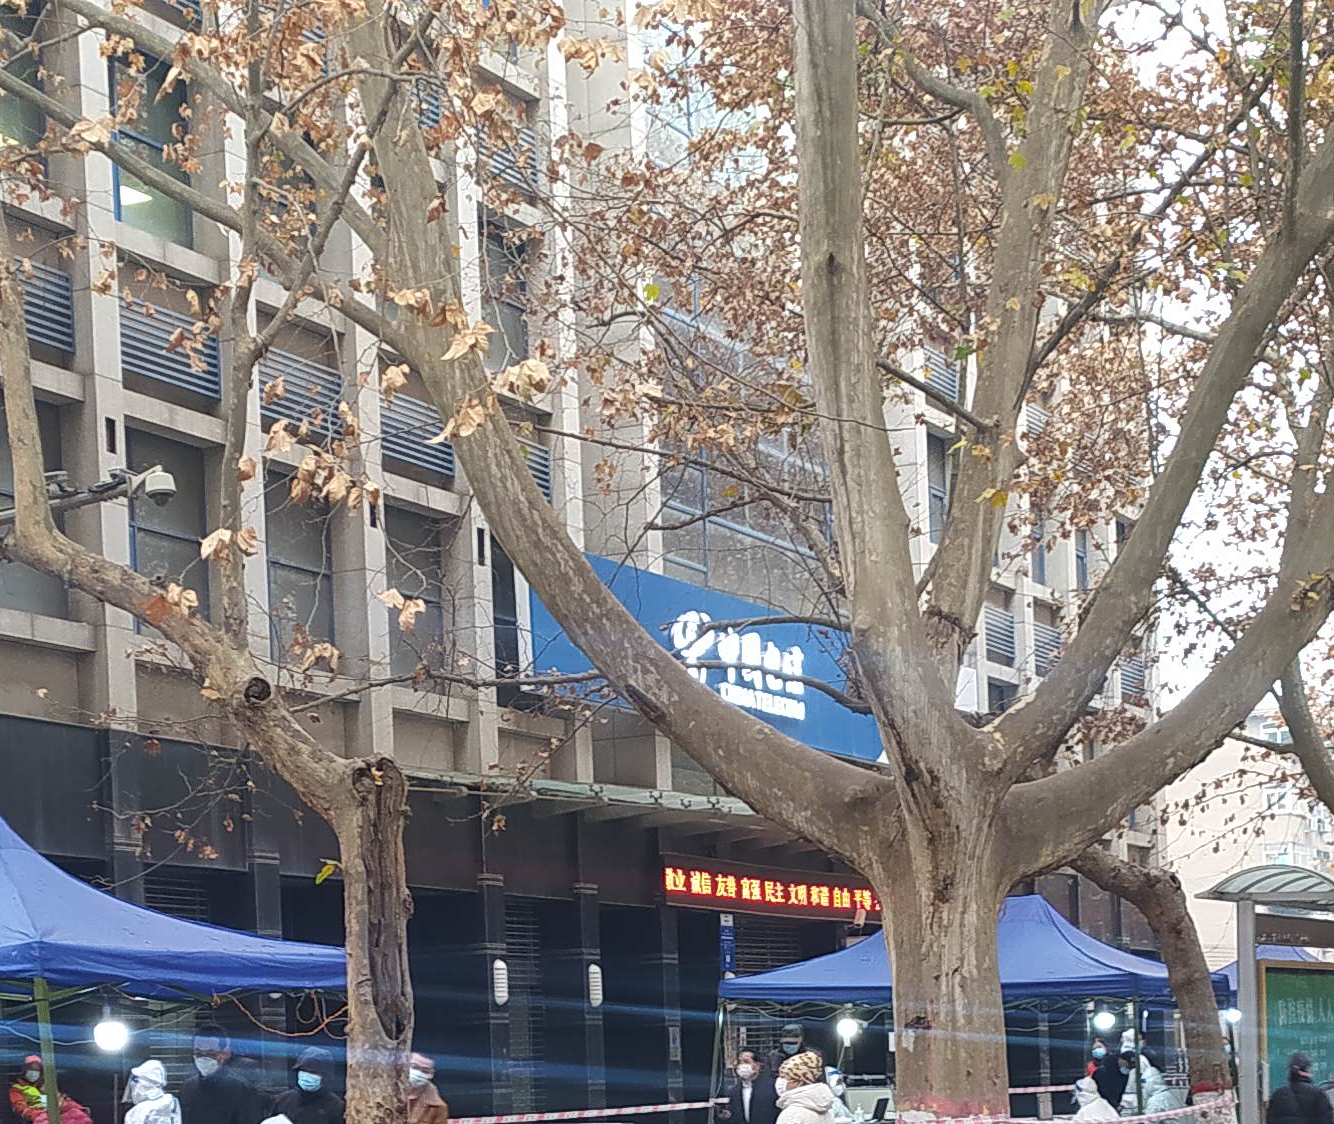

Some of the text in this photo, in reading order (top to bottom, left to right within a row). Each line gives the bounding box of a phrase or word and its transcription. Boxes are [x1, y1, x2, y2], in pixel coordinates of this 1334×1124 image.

[690, 870, 712, 895] 诚信
[715, 874, 737, 899] 友善
[741, 877, 762, 900] 富强
[764, 880, 786, 902] 民主
[787, 883, 807, 906] 文明
[810, 885, 829, 907] 和谐
[832, 887, 851, 908] 自由
[853, 889, 872, 911] 平等
